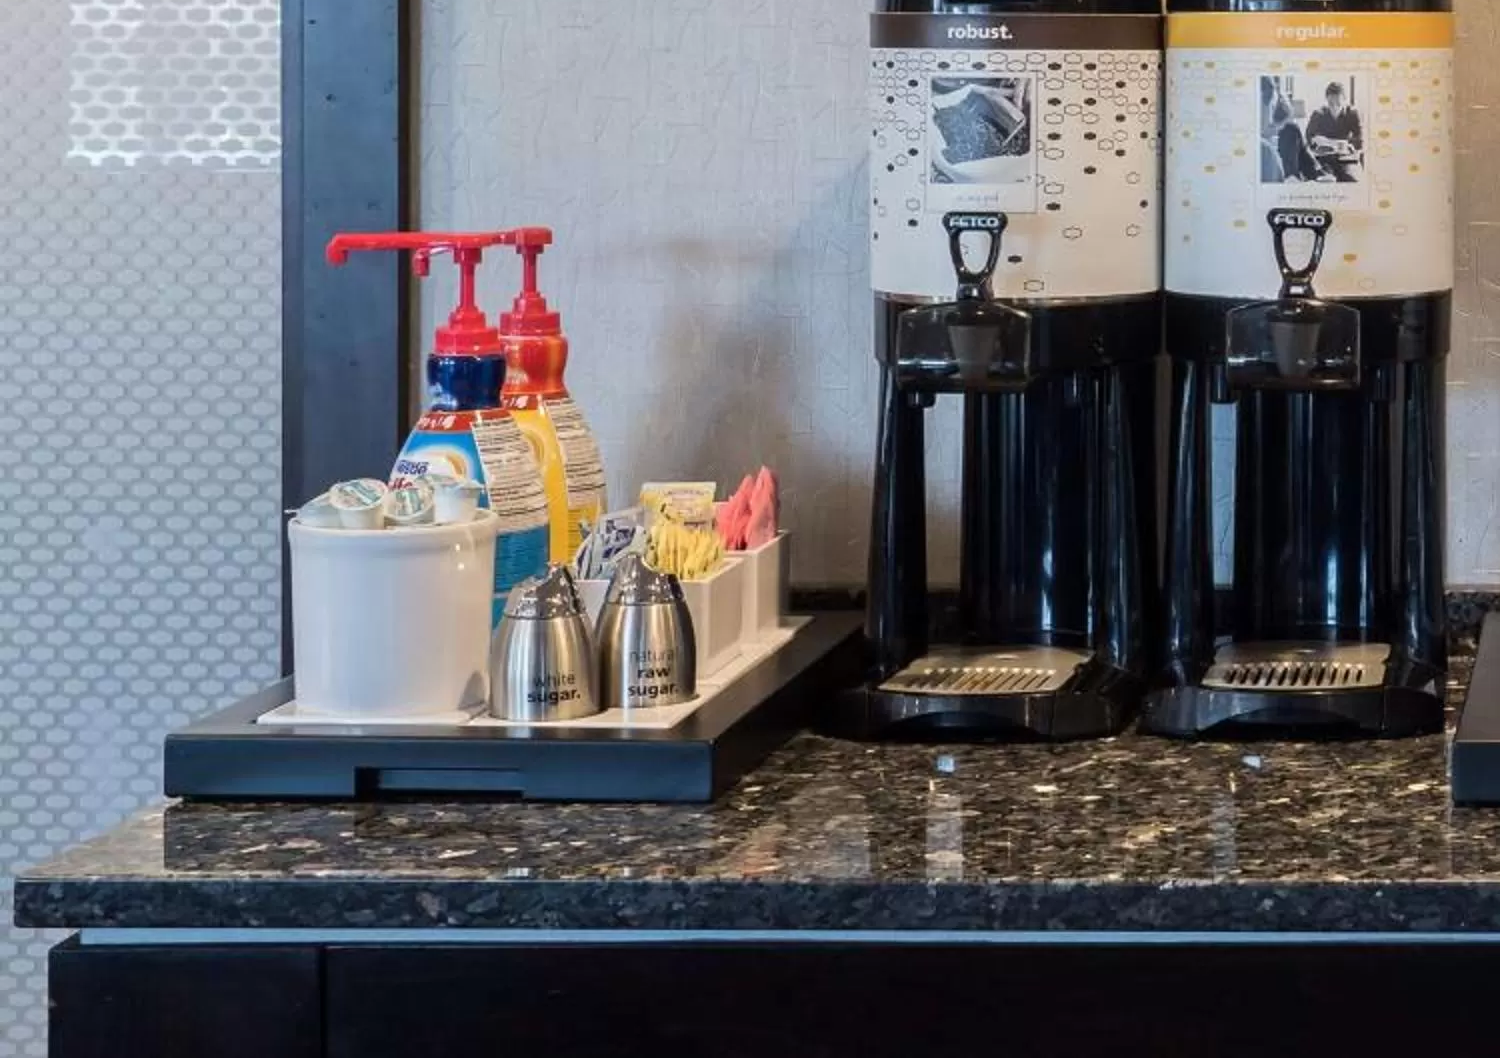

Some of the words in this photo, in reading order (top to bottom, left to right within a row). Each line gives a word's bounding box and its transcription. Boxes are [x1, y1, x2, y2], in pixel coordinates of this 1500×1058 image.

[947, 23, 1013, 39] robust.
[1276, 22, 1349, 41] regular.
[949, 216, 999, 228] FETCO
[1273, 213, 1325, 226] FETCO
[534, 669, 576, 688] white
[637, 666, 672, 679] raw
[527, 687, 581, 705] sugar.
[627, 682, 680, 699] sugar.
